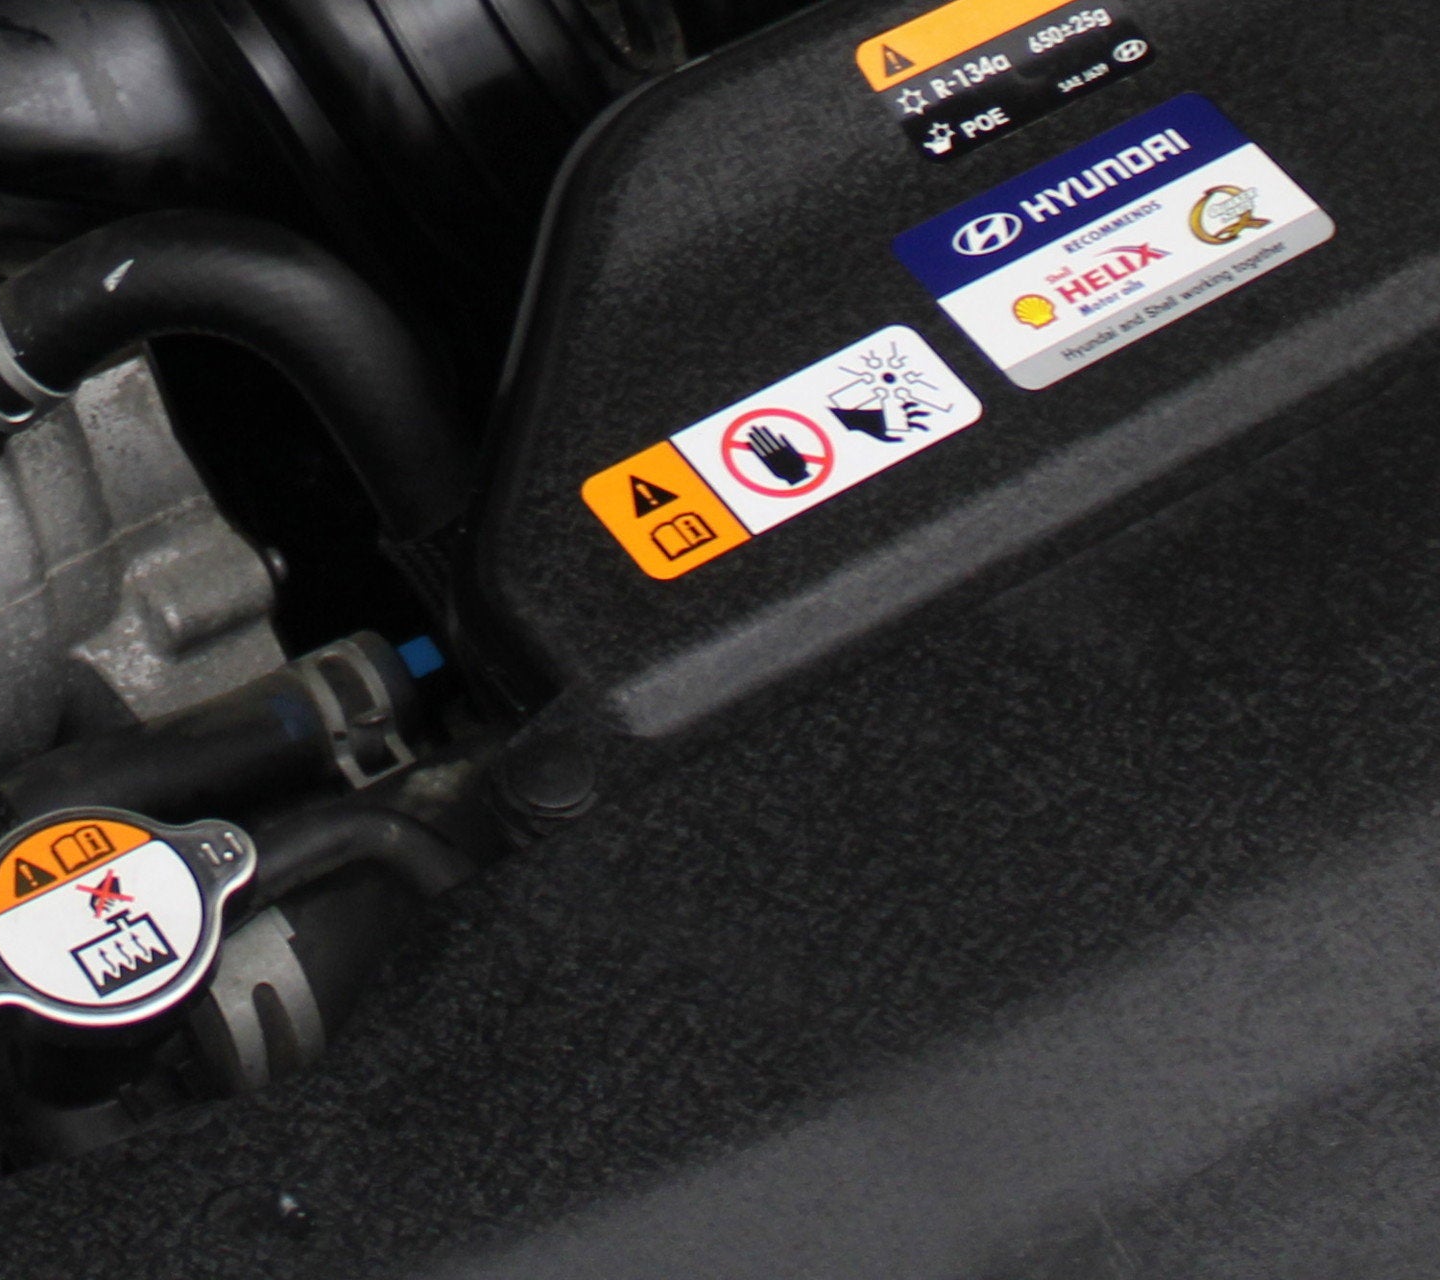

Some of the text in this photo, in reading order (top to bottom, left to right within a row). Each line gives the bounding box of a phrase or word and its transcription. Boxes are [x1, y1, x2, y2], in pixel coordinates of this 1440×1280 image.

[929, 7, 1113, 101] R-134a 650±25g
[959, 106, 1011, 140] POE
[1020, 128, 1192, 223] HYUNDAI
[1062, 200, 1162, 255] RECOMMENDS
[1055, 243, 1171, 304] HELIX
[1061, 240, 1287, 363] Hyundai and Shell working together
[1078, 291, 1119, 317] Motor
